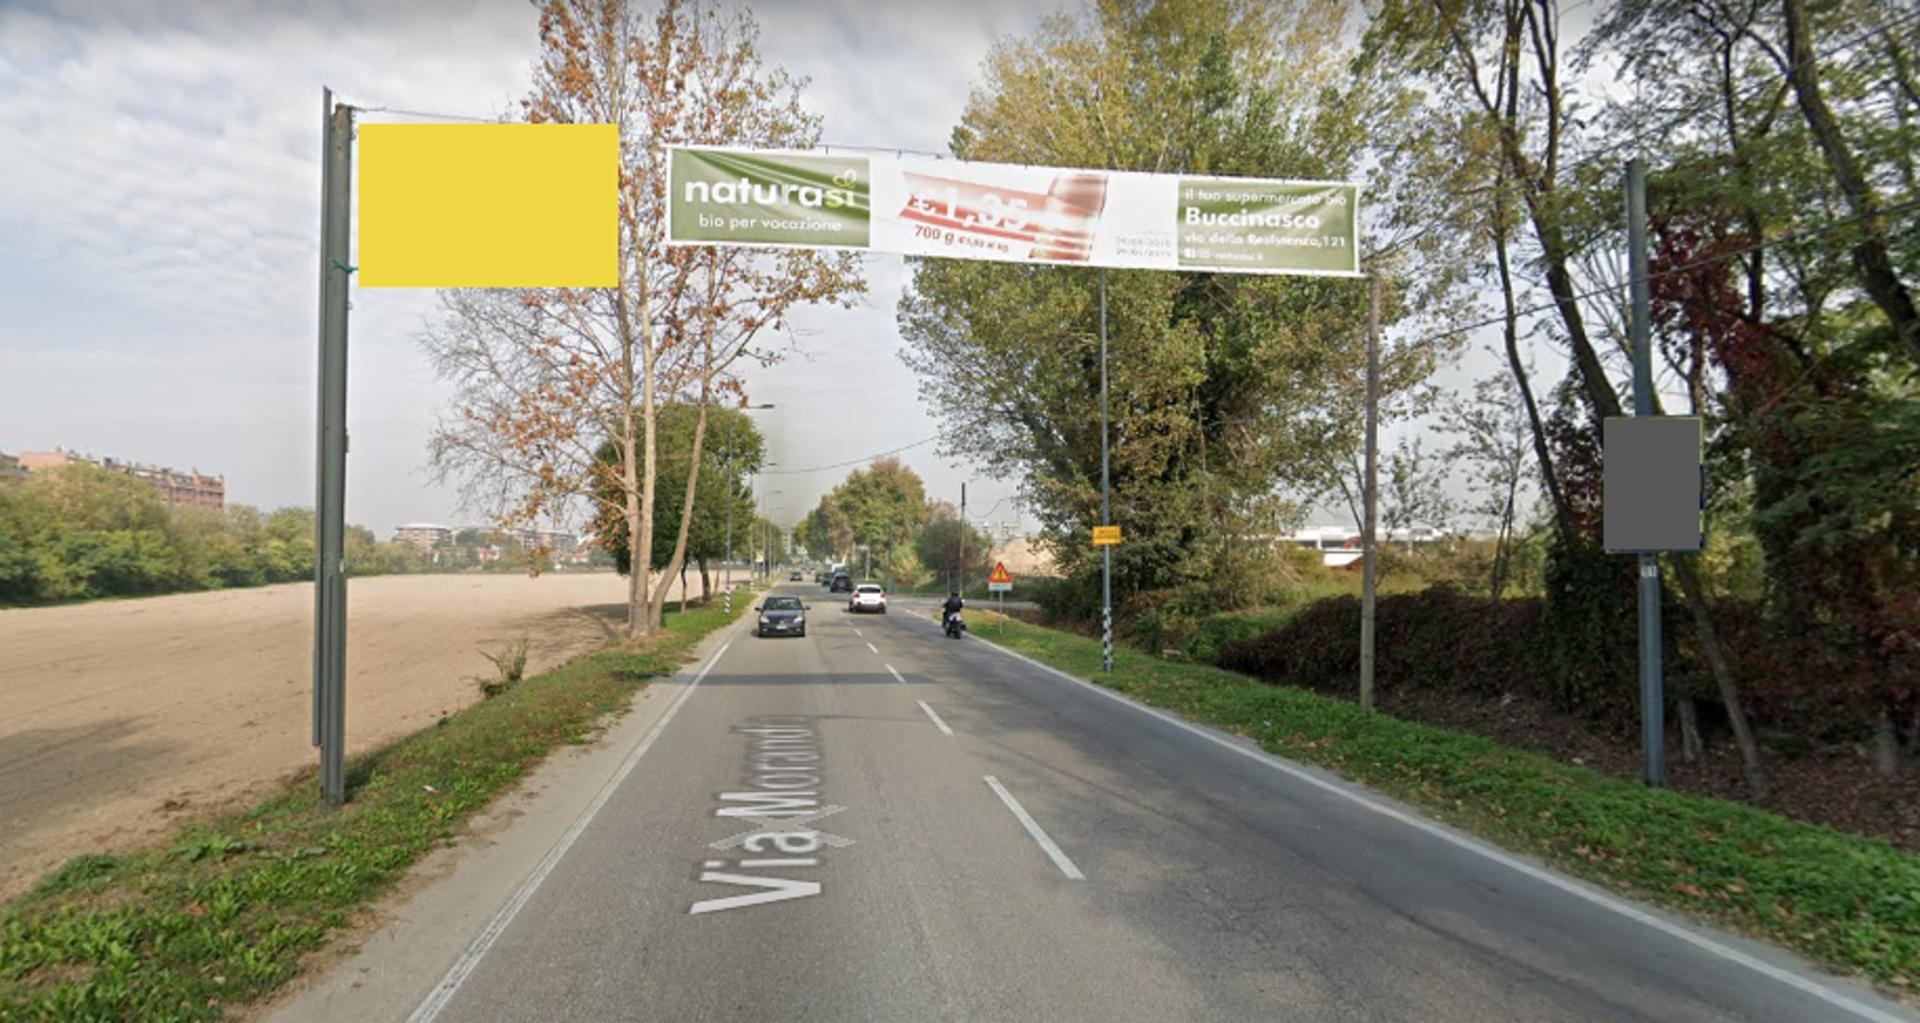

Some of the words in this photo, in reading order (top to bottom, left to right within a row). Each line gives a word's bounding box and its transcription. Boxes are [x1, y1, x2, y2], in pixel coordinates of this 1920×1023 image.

[1184, 188, 1194, 201] il
[1198, 190, 1222, 202] tuo
[1225, 191, 1321, 206] supermercato
[699, 213, 725, 228] bio
[729, 216, 755, 231] per
[762, 215, 843, 232] vocazione
[1185, 207, 1321, 229] Buccinasco
[914, 224, 940, 241] 700
[944, 231, 954, 246] g
[1184, 232, 1205, 244] via
[1209, 232, 1244, 245] della
